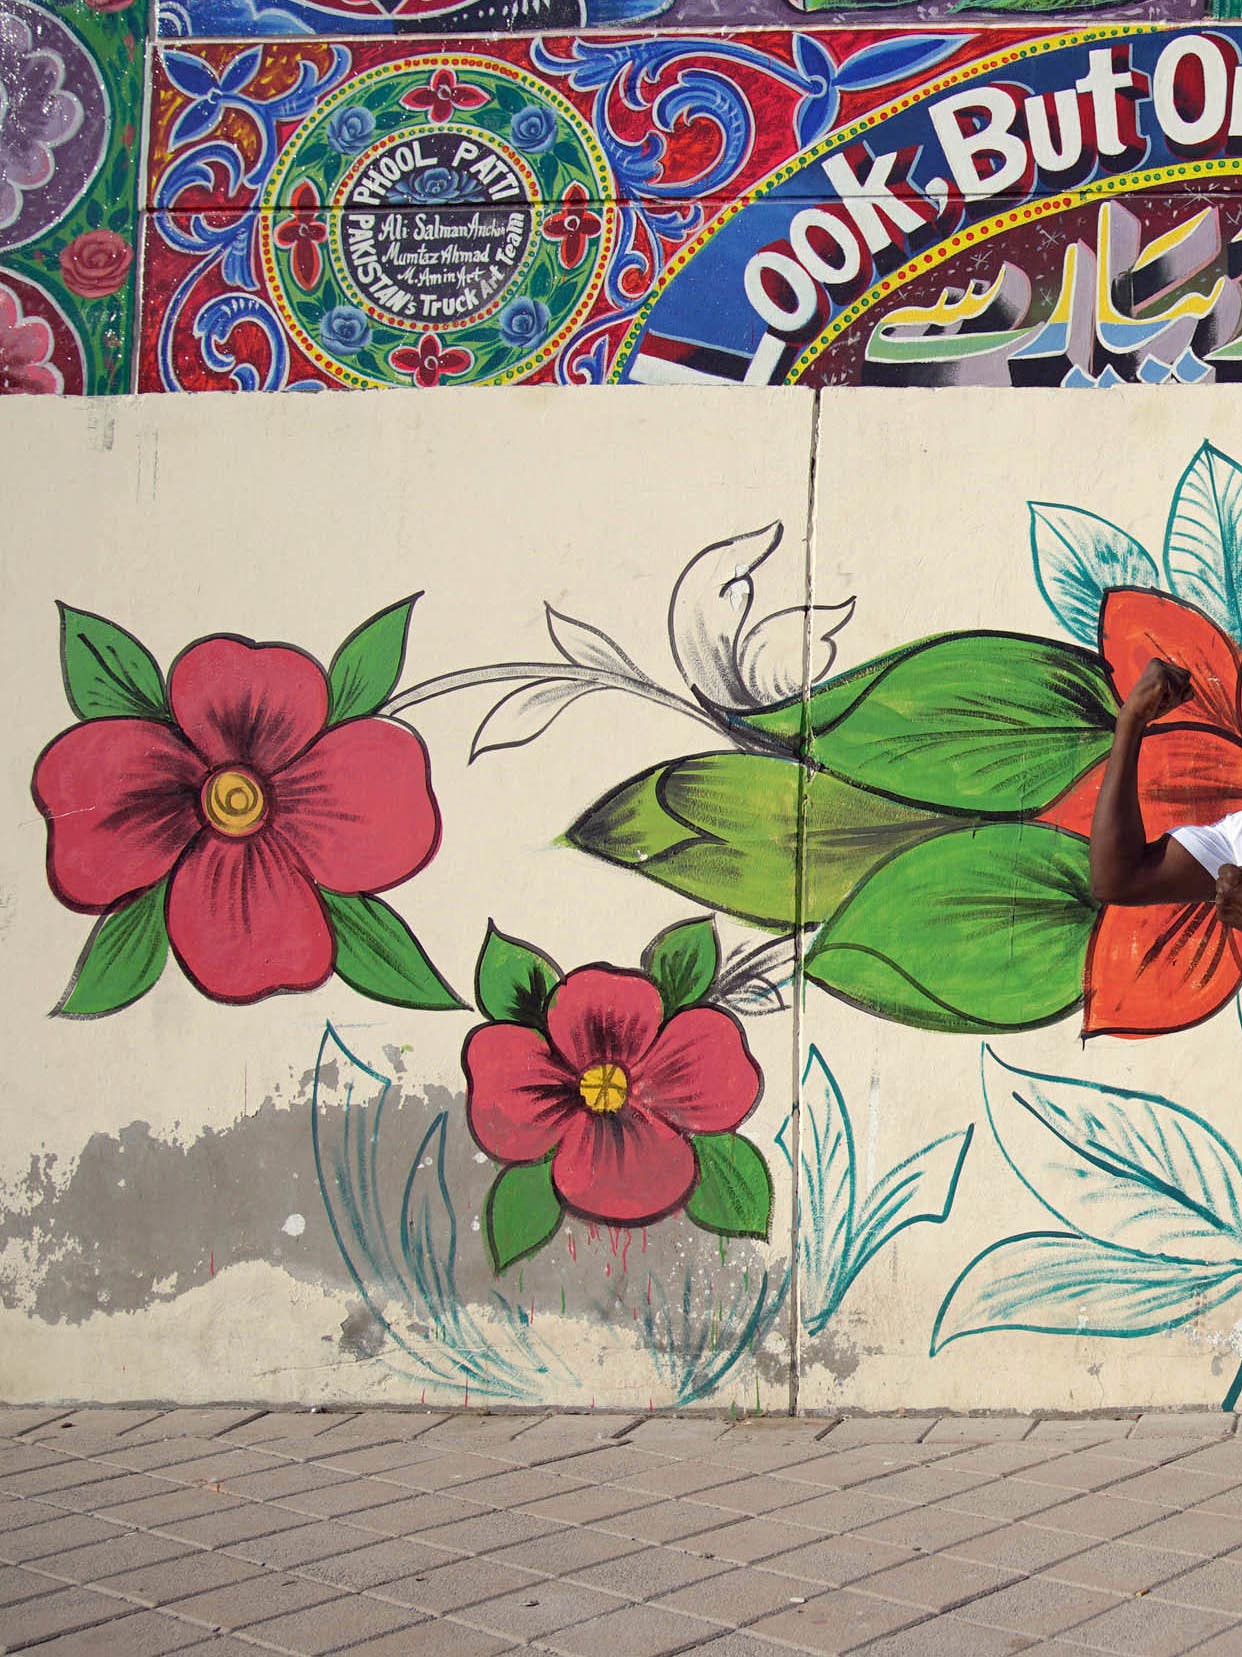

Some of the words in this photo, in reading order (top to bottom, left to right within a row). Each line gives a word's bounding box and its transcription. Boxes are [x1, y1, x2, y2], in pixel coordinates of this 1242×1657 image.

[927, 47, 1134, 203] But
[352, 140, 438, 206] PHOOL
[451, 140, 521, 201] PATTI
[378, 213, 408, 242] Ali
[413, 212, 468, 241] Salman
[495, 212, 525, 266] Team
[381, 241, 440, 267] Mumtaz
[440, 243, 491, 265] Ahmad
[456, 266, 486, 289] Art
